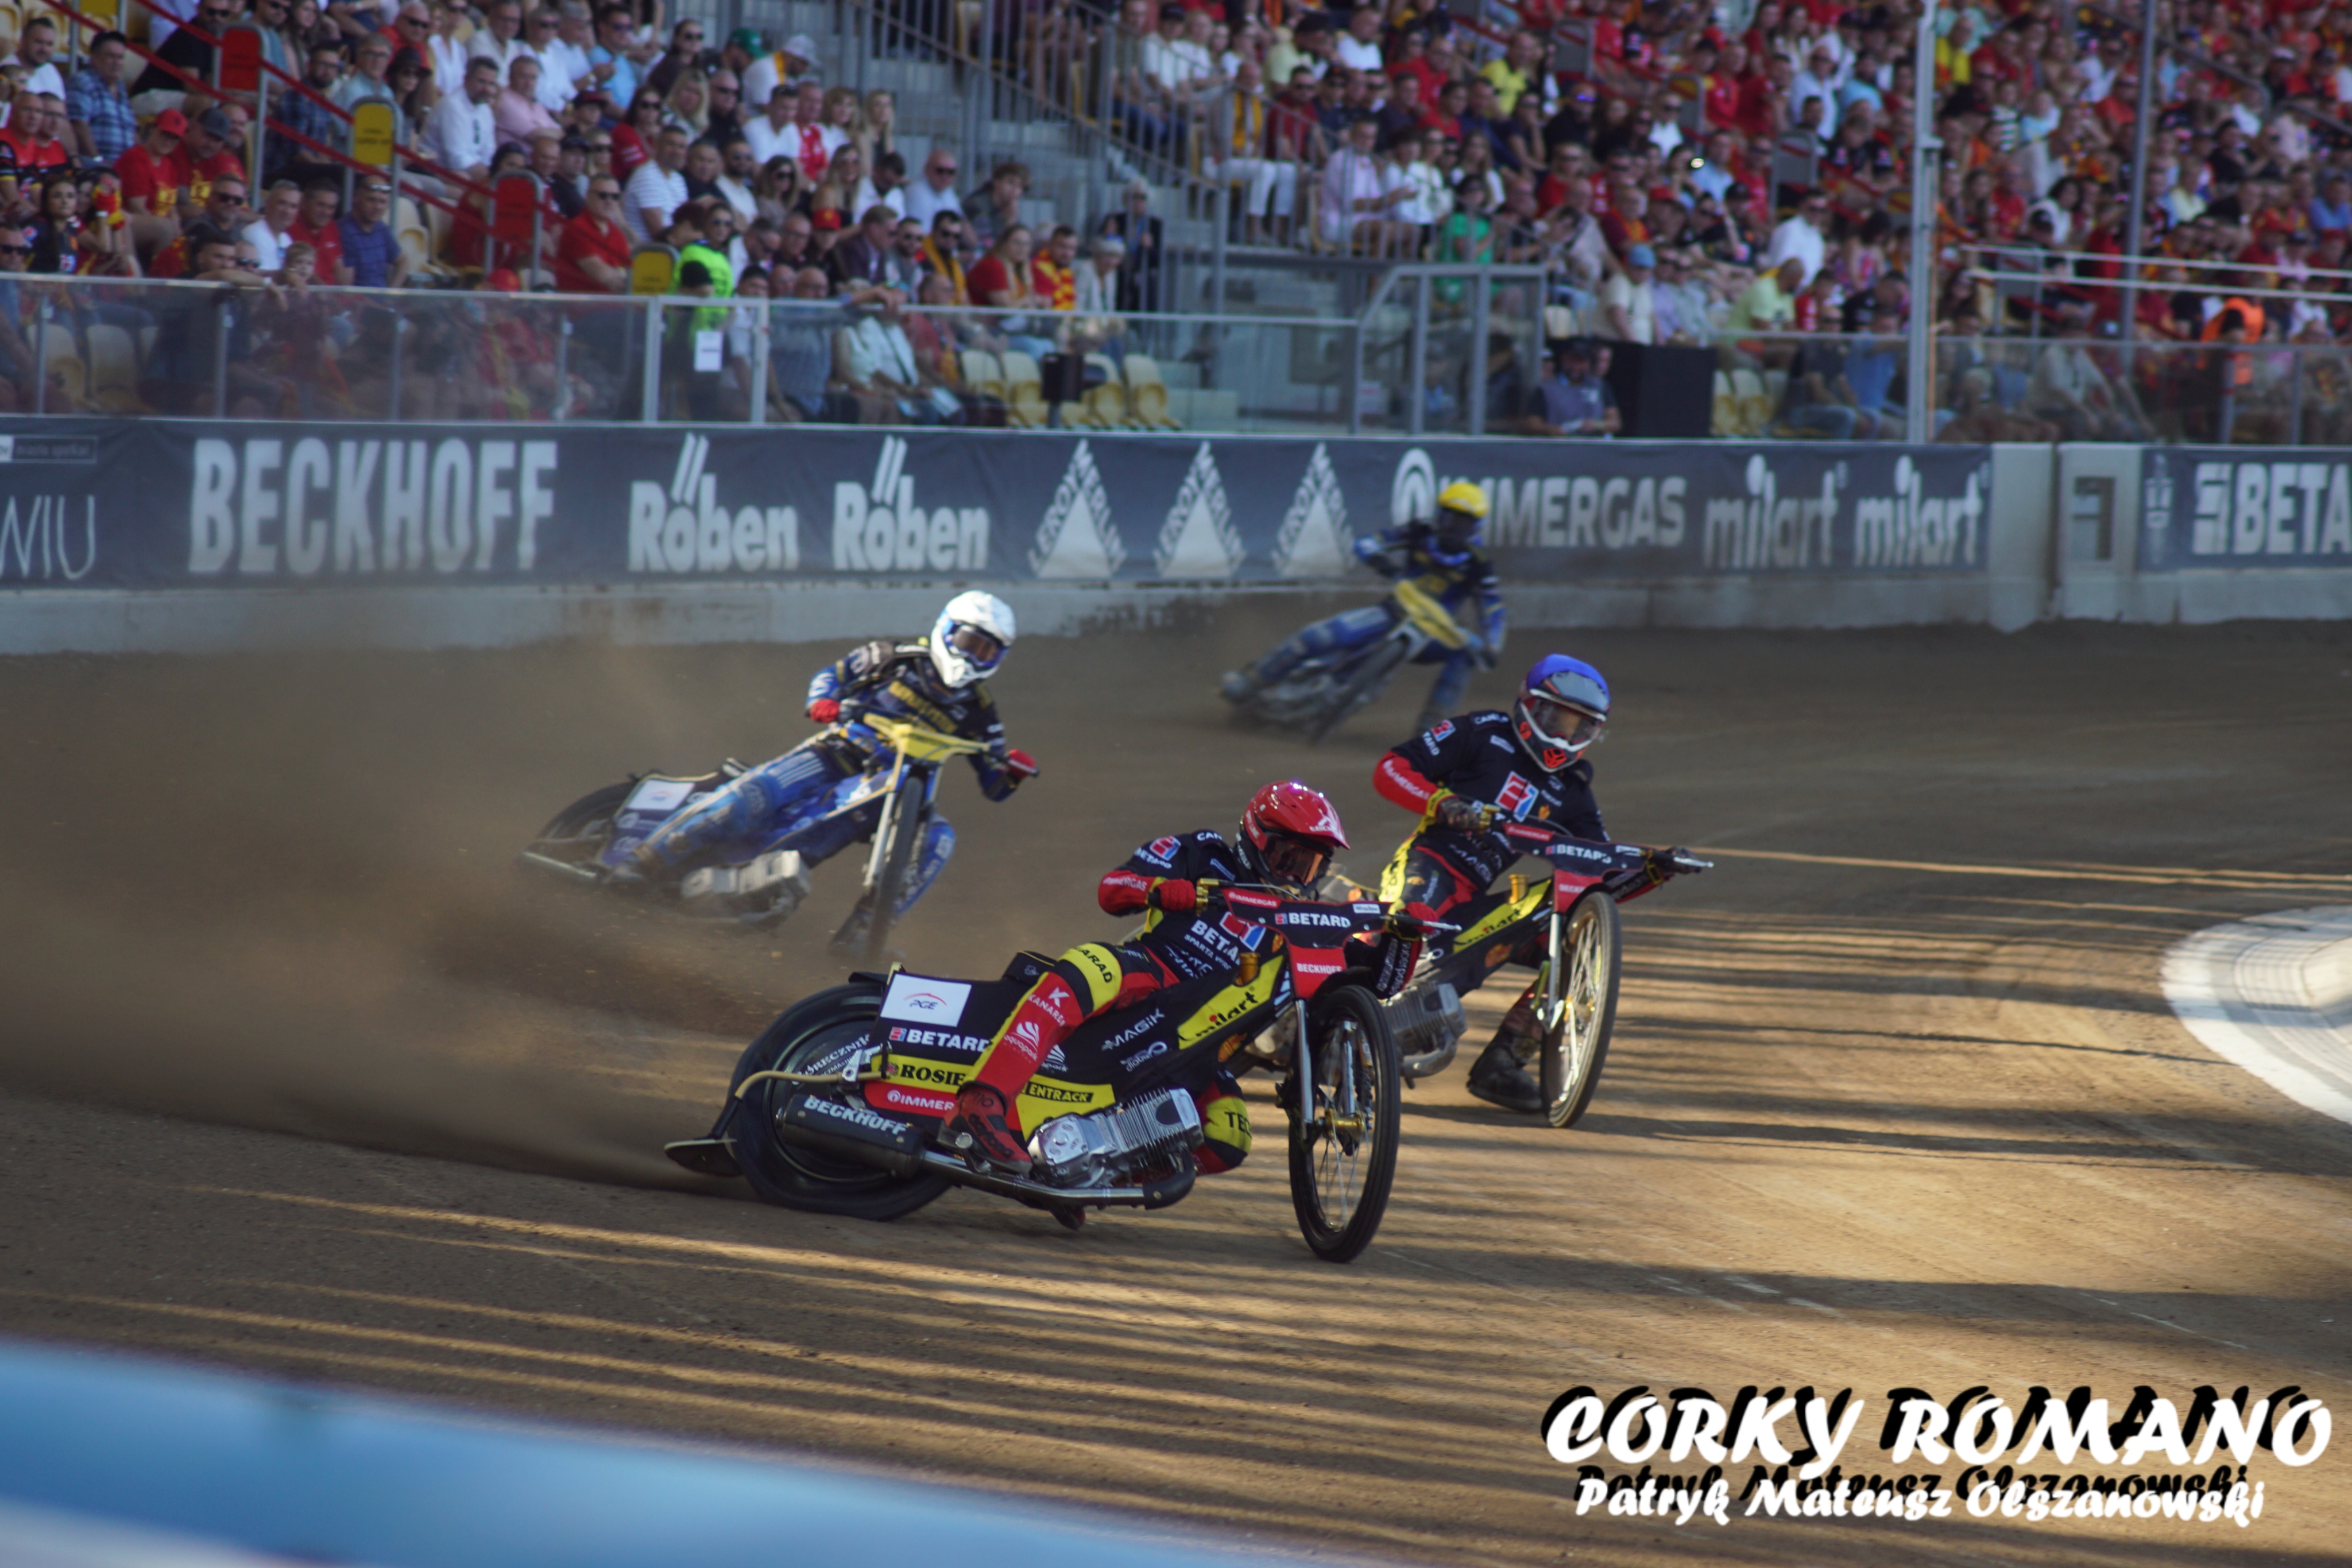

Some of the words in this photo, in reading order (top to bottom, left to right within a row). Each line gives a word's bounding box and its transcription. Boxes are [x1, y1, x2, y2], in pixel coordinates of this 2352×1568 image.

[189, 438, 557, 573] BECKHOFF
[628, 432, 799, 572] Röben
[833, 435, 990, 572] Röben
[1440, 477, 1687, 549] MERGAS
[1703, 455, 1838, 568] milart
[1855, 455, 1982, 566] milart
[1422, 731, 1440, 756] TARD
[1288, 912, 1352, 928] BETARD
[1190, 919, 1241, 966] BETA
[1076, 947, 1113, 984] ARAD
[1295, 962, 1343, 974] BECKHOFF
[906, 1029, 992, 1053] BETARD
[900, 1064, 966, 1086] ROSIE
[804, 1096, 908, 1135] BECKHOFF
[900, 1095, 955, 1111] IMMER
